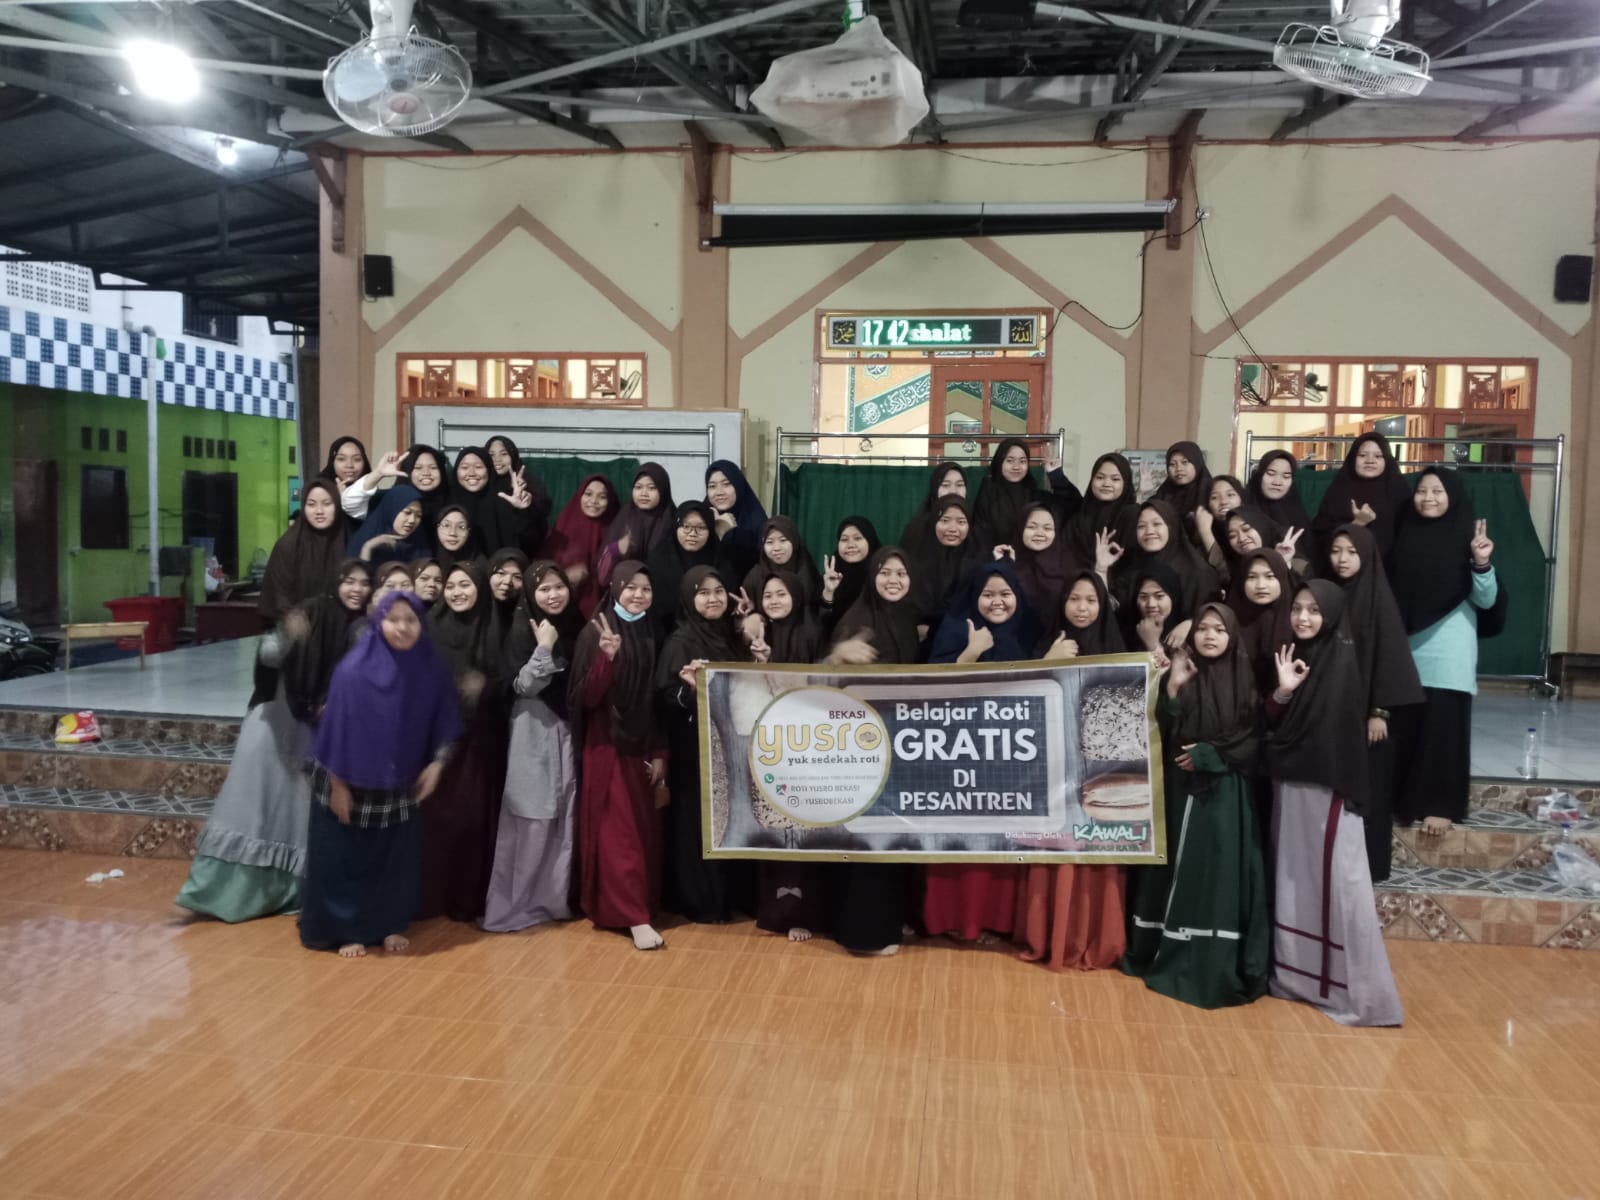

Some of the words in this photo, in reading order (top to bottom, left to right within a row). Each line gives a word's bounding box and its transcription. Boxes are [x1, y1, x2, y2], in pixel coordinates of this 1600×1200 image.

[909, 322, 972, 342] shalat
[828, 710, 866, 720] BEKASI
[895, 701, 978, 727] Belajar
[983, 700, 1030, 721] Roti
[757, 722, 882, 767] yusro
[893, 727, 1038, 762] GRATIS
[787, 755, 809, 767] yuk
[811, 754, 858, 764] sedekah
[859, 754, 880, 764] roti
[790, 784, 808, 792] ROTI
[953, 768, 977, 788] DI
[899, 791, 1033, 811] PESANTREN
[1072, 823, 1148, 842] KAWALI
